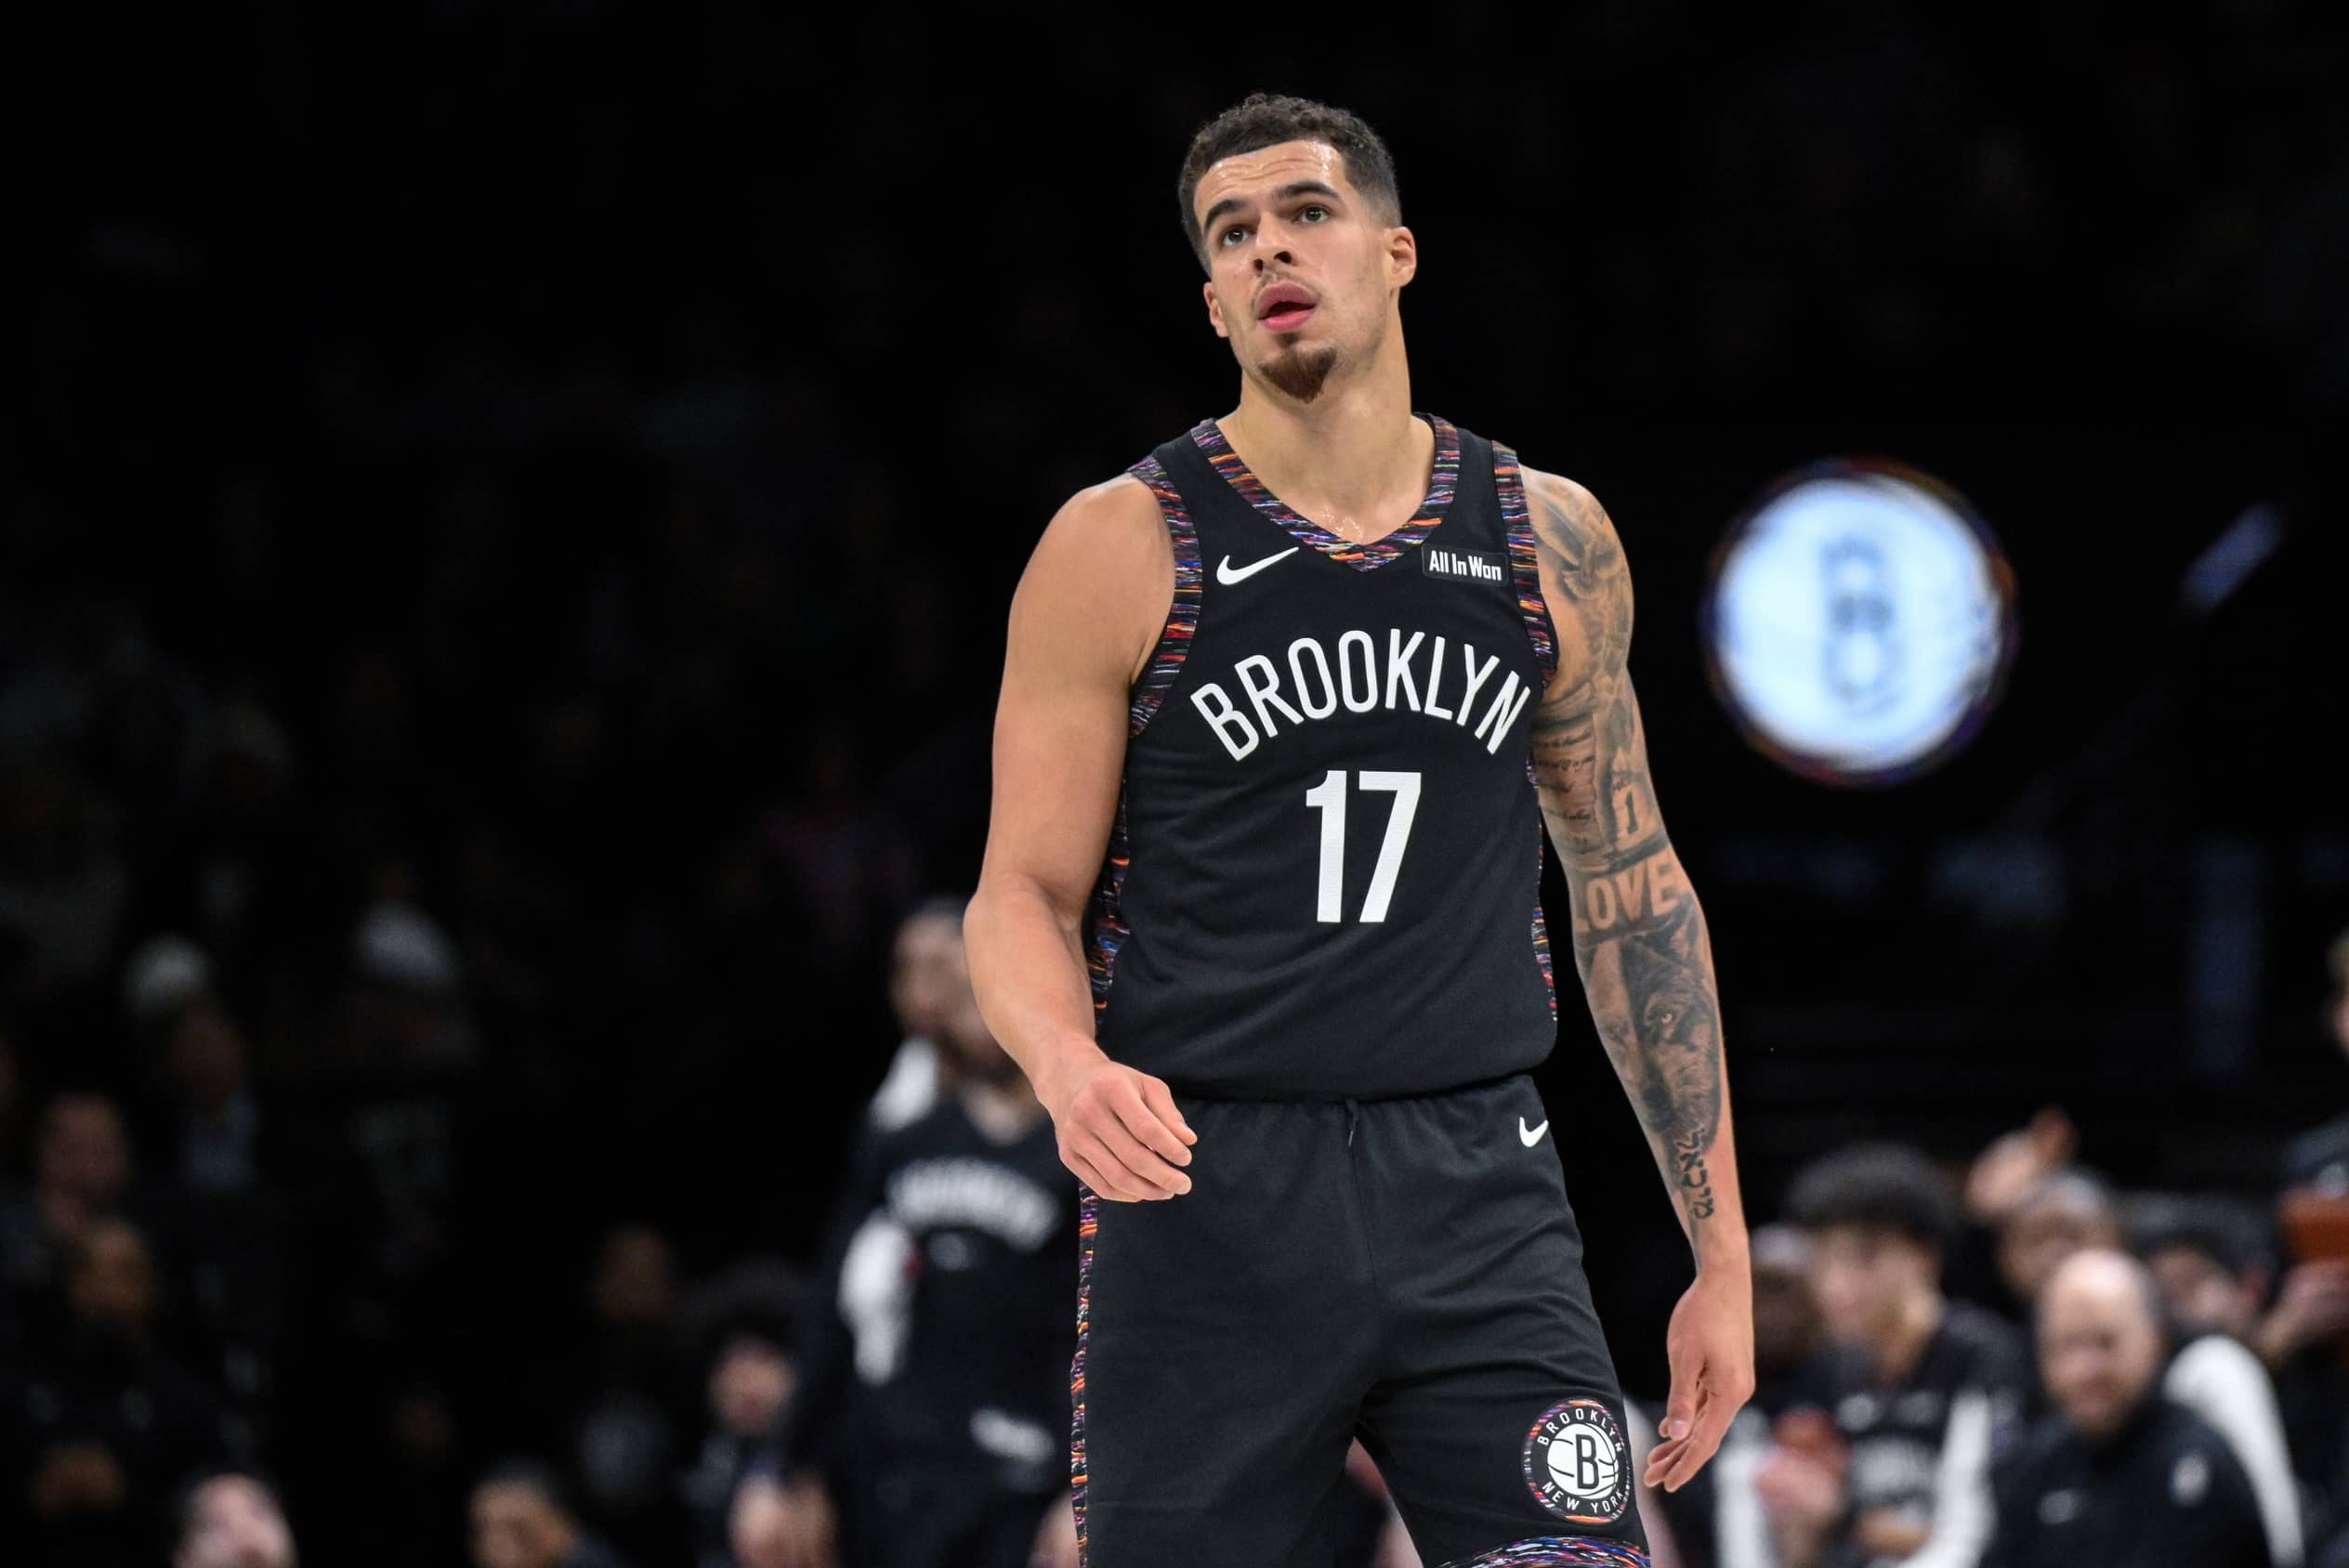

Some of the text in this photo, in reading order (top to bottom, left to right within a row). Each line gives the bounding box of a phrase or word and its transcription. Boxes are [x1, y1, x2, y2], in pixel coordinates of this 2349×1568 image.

[1429, 550, 1503, 581] All In Won
[1190, 628, 1531, 762] BROOKLYN
[1306, 769, 1422, 923] 17
[1537, 1407, 1623, 1452] BROOKLYN
[1575, 1433, 1599, 1489] B
[1542, 1481, 1624, 1514] NEW YORK
